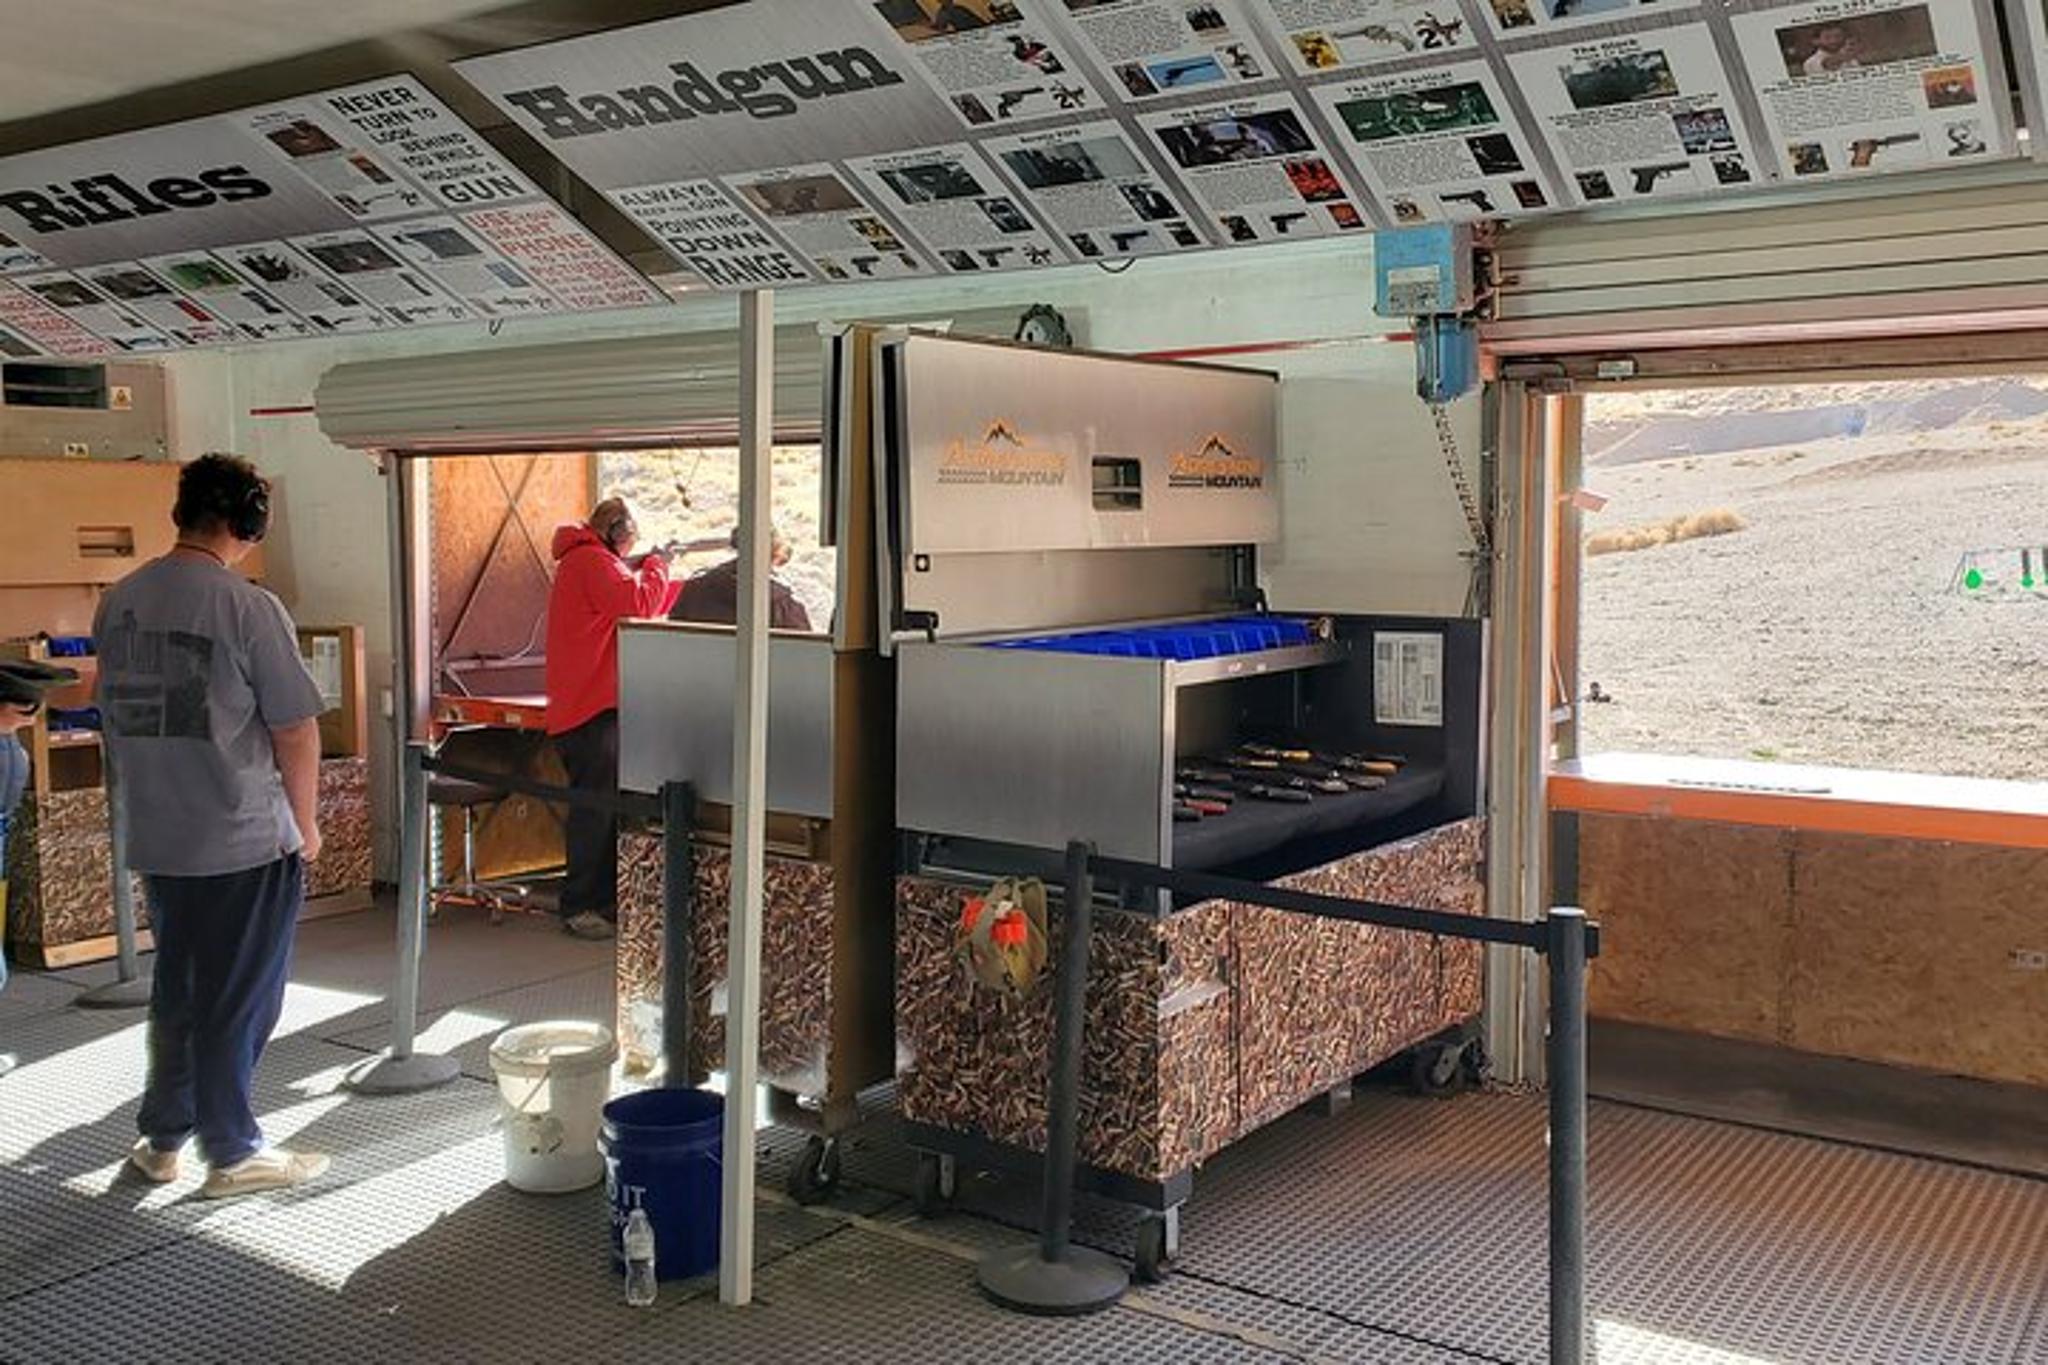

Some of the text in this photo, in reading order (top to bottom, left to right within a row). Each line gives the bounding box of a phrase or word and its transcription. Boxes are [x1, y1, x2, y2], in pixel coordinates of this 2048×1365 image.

[327, 86, 419, 117] NEVER
[503, 46, 905, 140] Handgun
[351, 106, 438, 132] TURN TO
[370, 127, 419, 145] LOOK
[400, 132, 468, 152] BEHIND
[0, 164, 272, 233] Rifles
[440, 175, 526, 203] GUN
[619, 183, 718, 206] ALWAYS
[688, 197, 730, 211] GUN
[466, 210, 516, 228] USE
[648, 213, 751, 234] POINTING
[500, 232, 594, 256] PHONE
[667, 230, 773, 254] DOWN
[688, 252, 807, 285] RANGE
